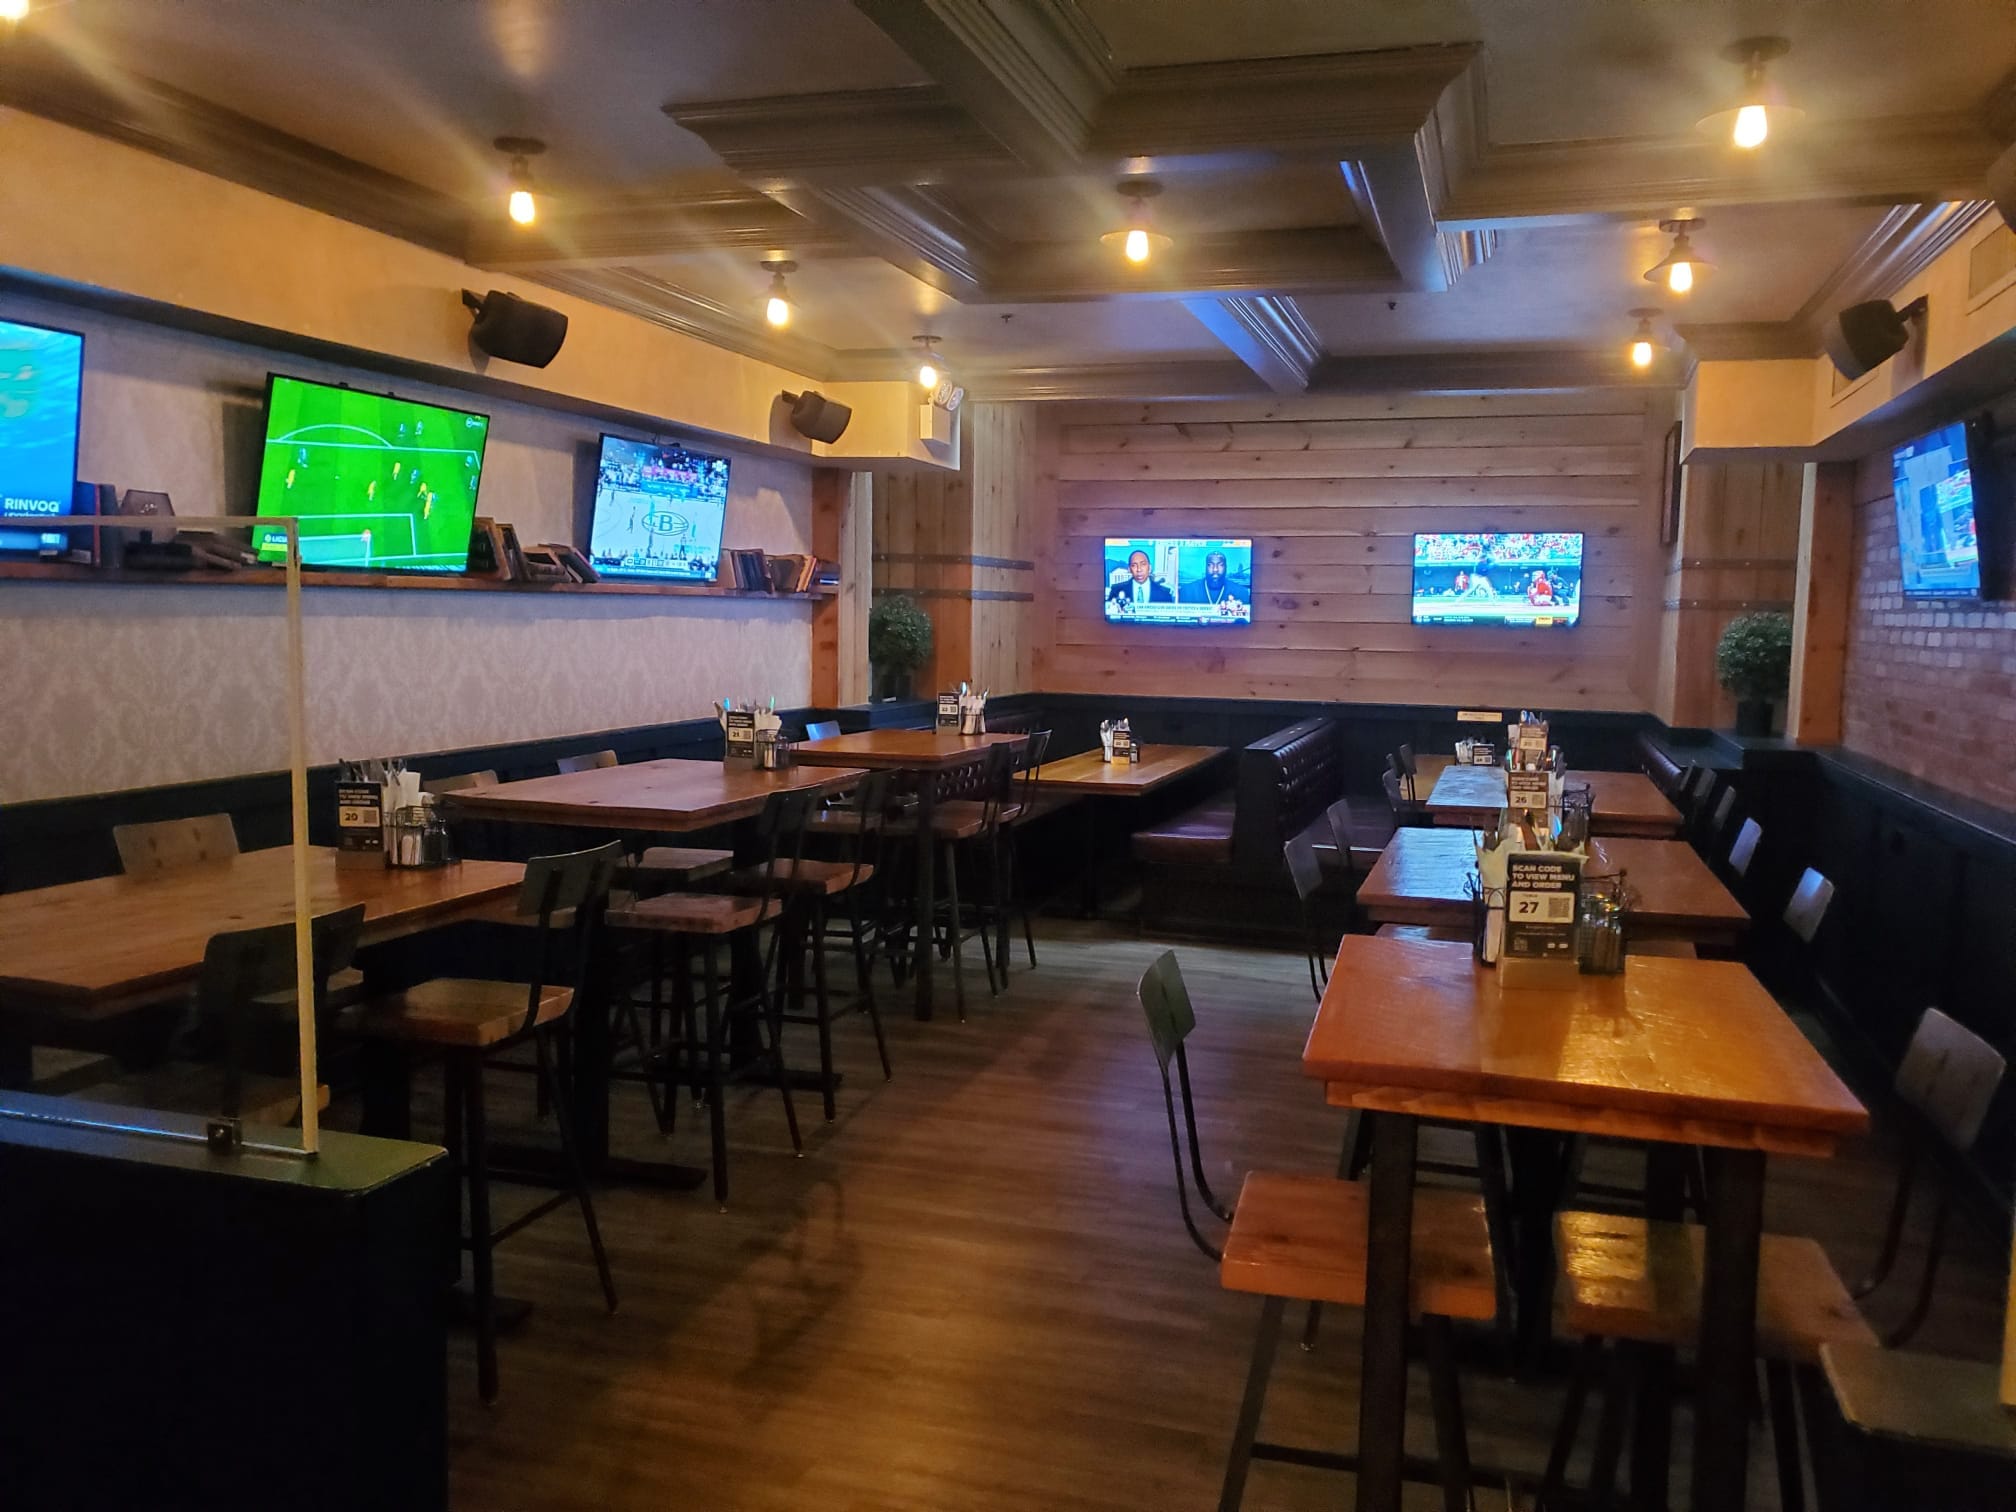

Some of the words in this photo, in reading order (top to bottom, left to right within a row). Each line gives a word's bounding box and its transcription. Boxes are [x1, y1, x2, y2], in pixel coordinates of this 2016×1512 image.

[4, 498, 60, 513] RINVOQ
[659, 515, 673, 531] B
[1515, 796, 1527, 804] 26
[345, 813, 358, 821] 20
[1519, 901, 1539, 914] 27
